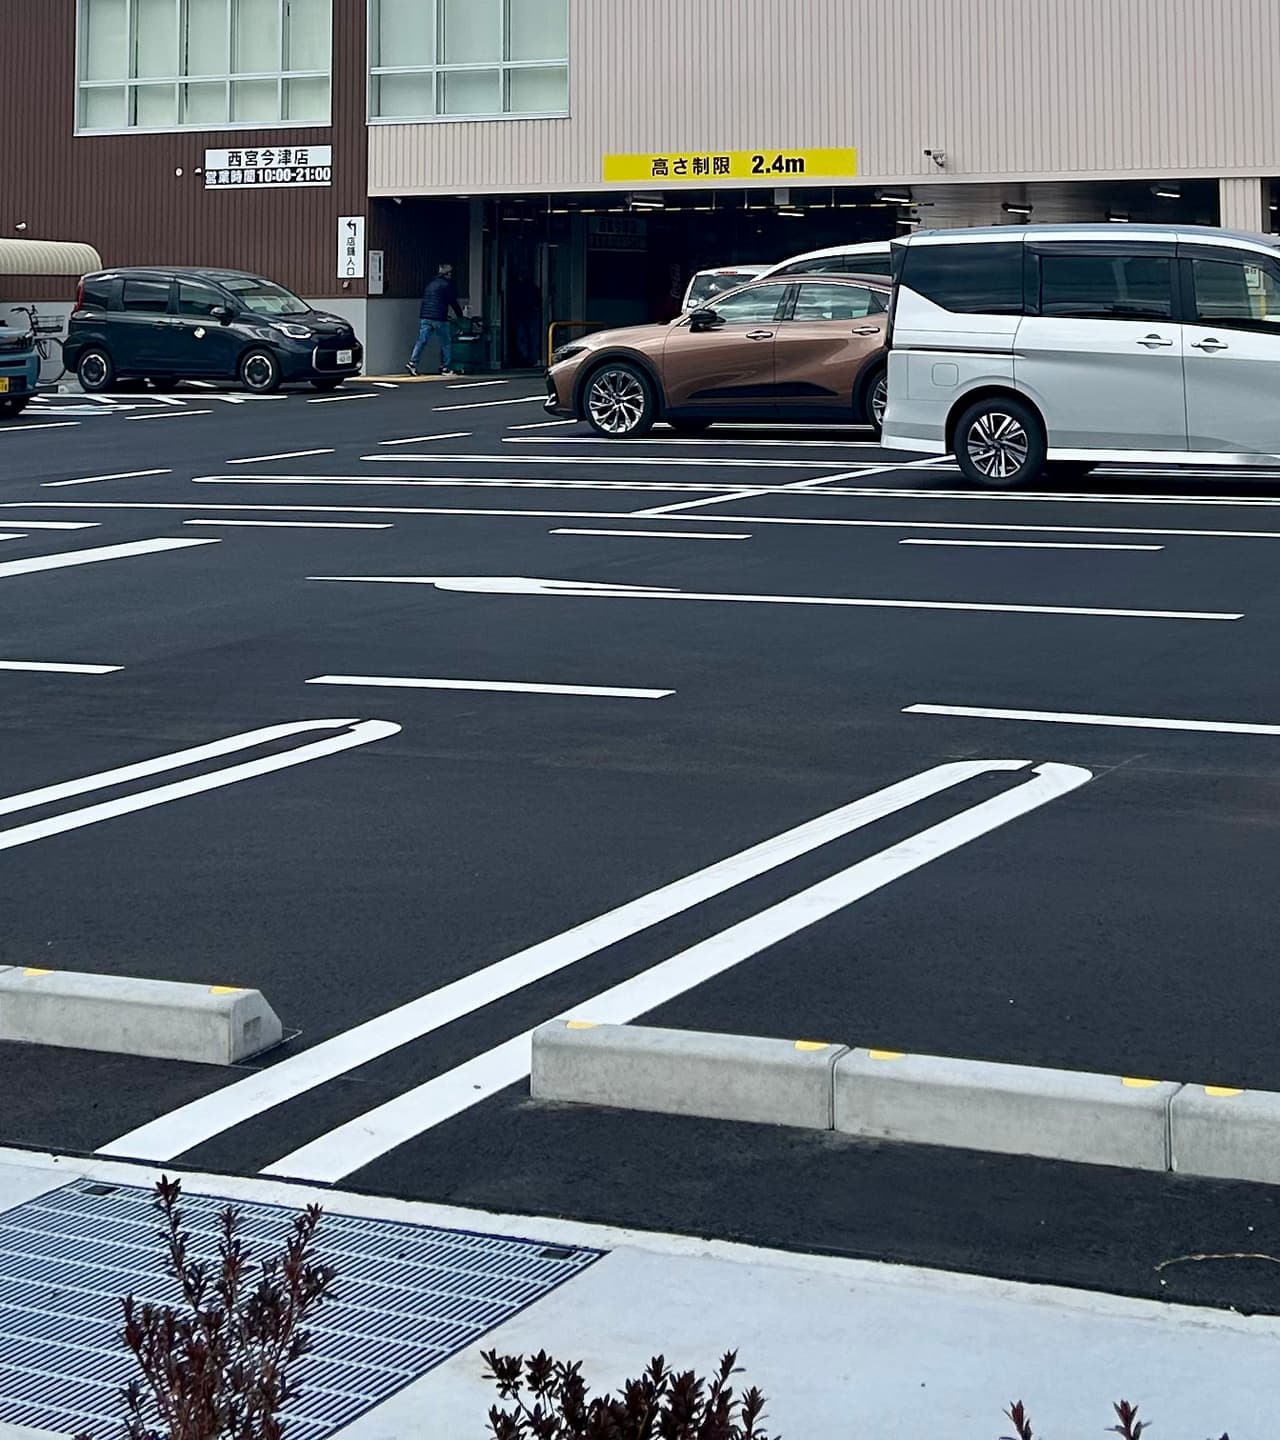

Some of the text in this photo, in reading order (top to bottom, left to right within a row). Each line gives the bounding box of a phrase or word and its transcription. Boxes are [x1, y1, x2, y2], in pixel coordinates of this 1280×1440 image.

[228, 149, 309, 167] 西宮今津店
[651, 155, 805, 176] 高さ制限 2.4m
[346, 237, 355, 276] 店舗入口
